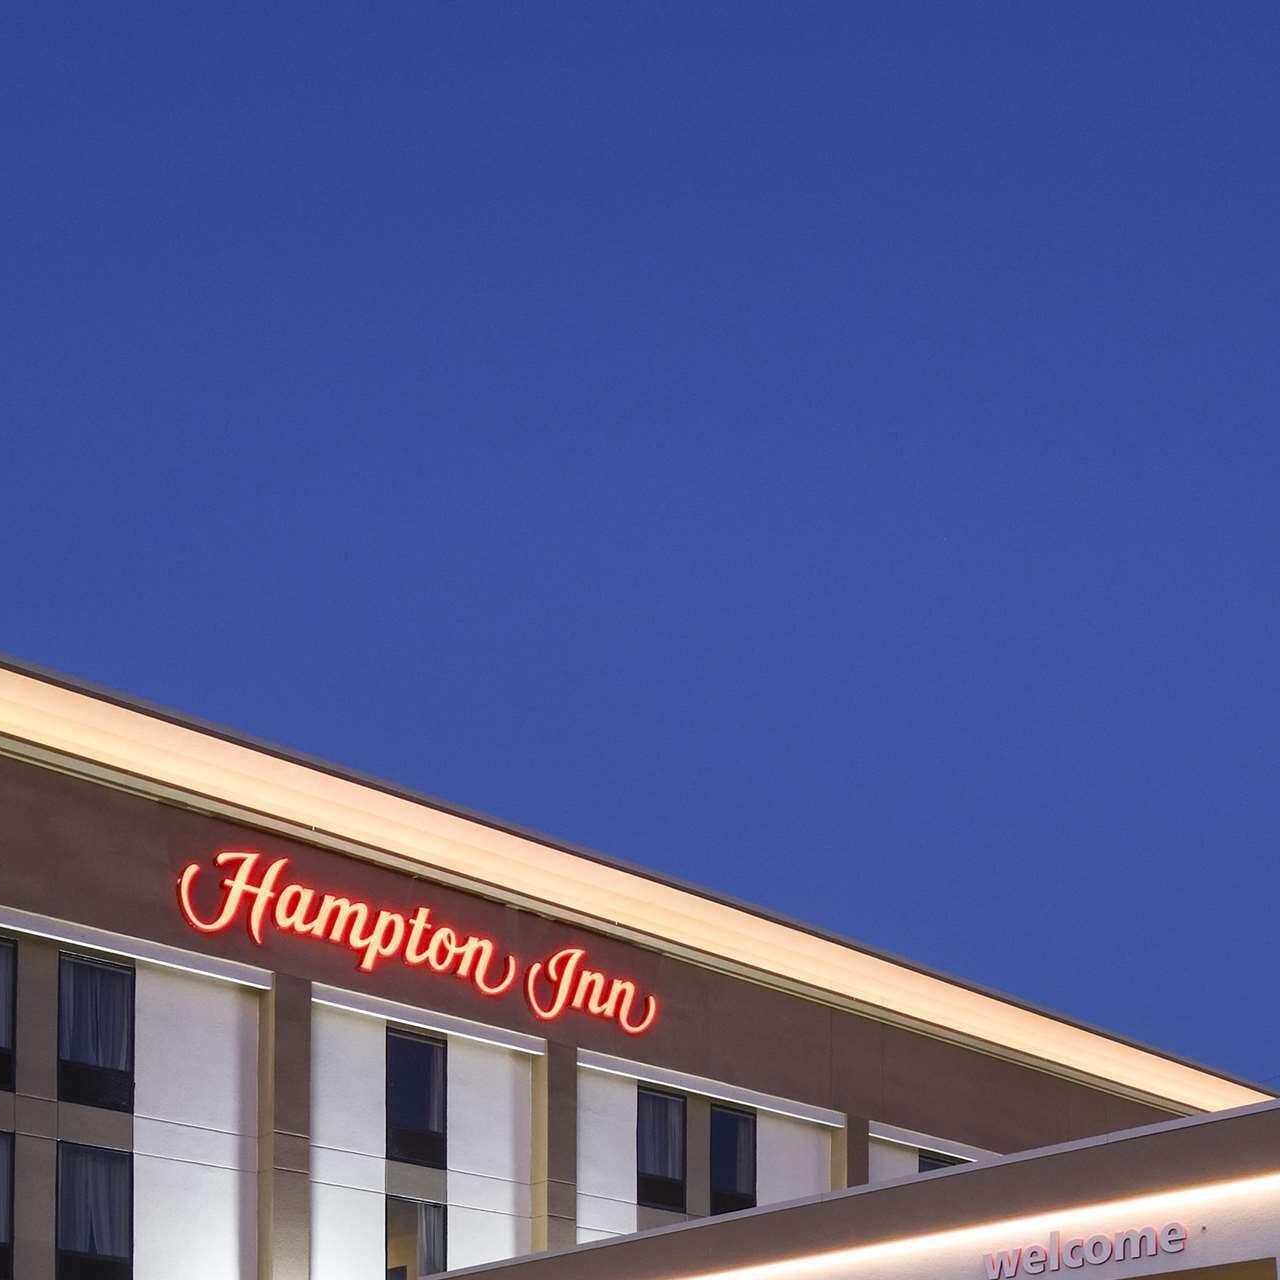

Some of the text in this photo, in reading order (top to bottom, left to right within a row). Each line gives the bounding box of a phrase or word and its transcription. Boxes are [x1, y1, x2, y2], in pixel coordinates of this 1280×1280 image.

[178, 850, 657, 1034] Hampton Inn
[982, 1221, 1188, 1280] welcome
